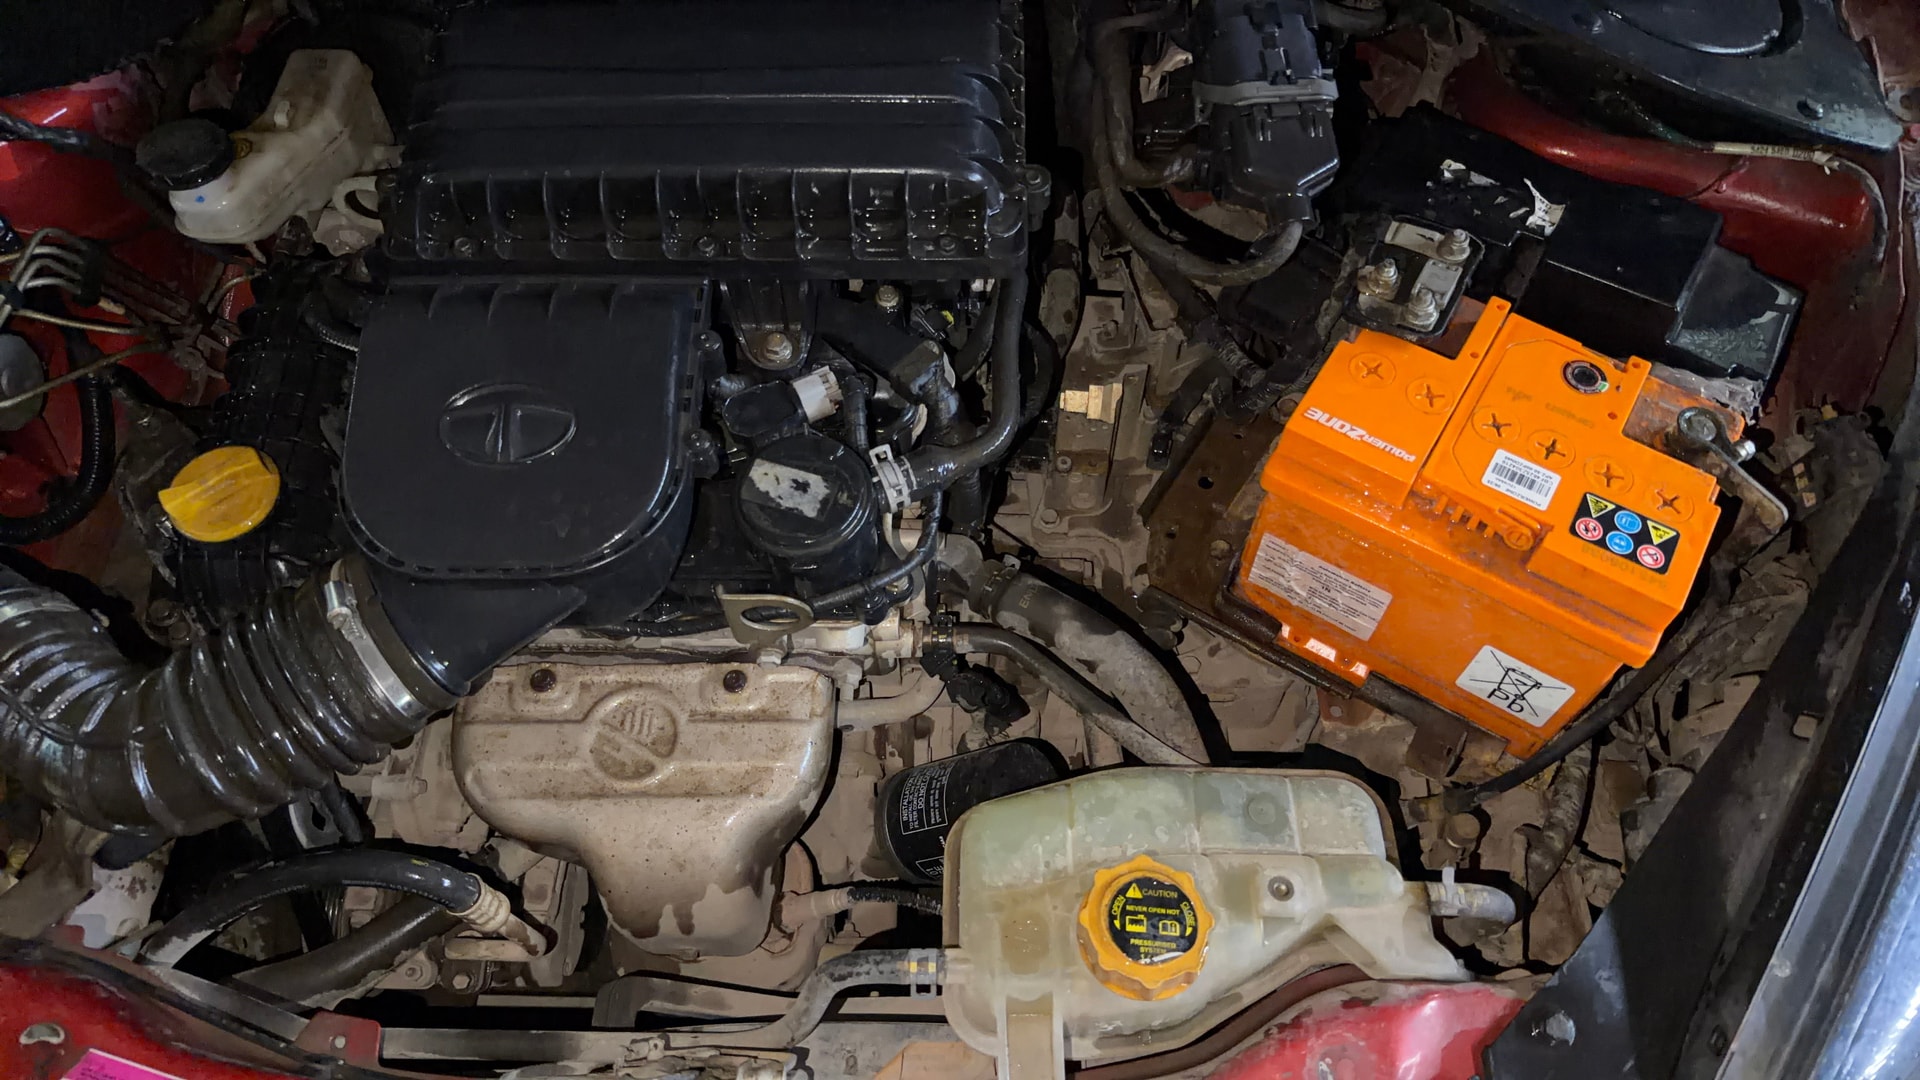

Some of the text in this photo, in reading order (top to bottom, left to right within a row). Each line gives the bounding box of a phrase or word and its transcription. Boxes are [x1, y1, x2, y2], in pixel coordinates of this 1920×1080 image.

[1303, 406, 1417, 463] POWERZONE
[1487, 688, 1524, 713] Pb
[917, 797, 925, 809] DO
[1142, 888, 1177, 898] CAUTION
[1111, 894, 1126, 916] OPEN
[1126, 904, 1180, 916] NEVER OPEN HOT
[1181, 901, 1196, 927] CLOSE
